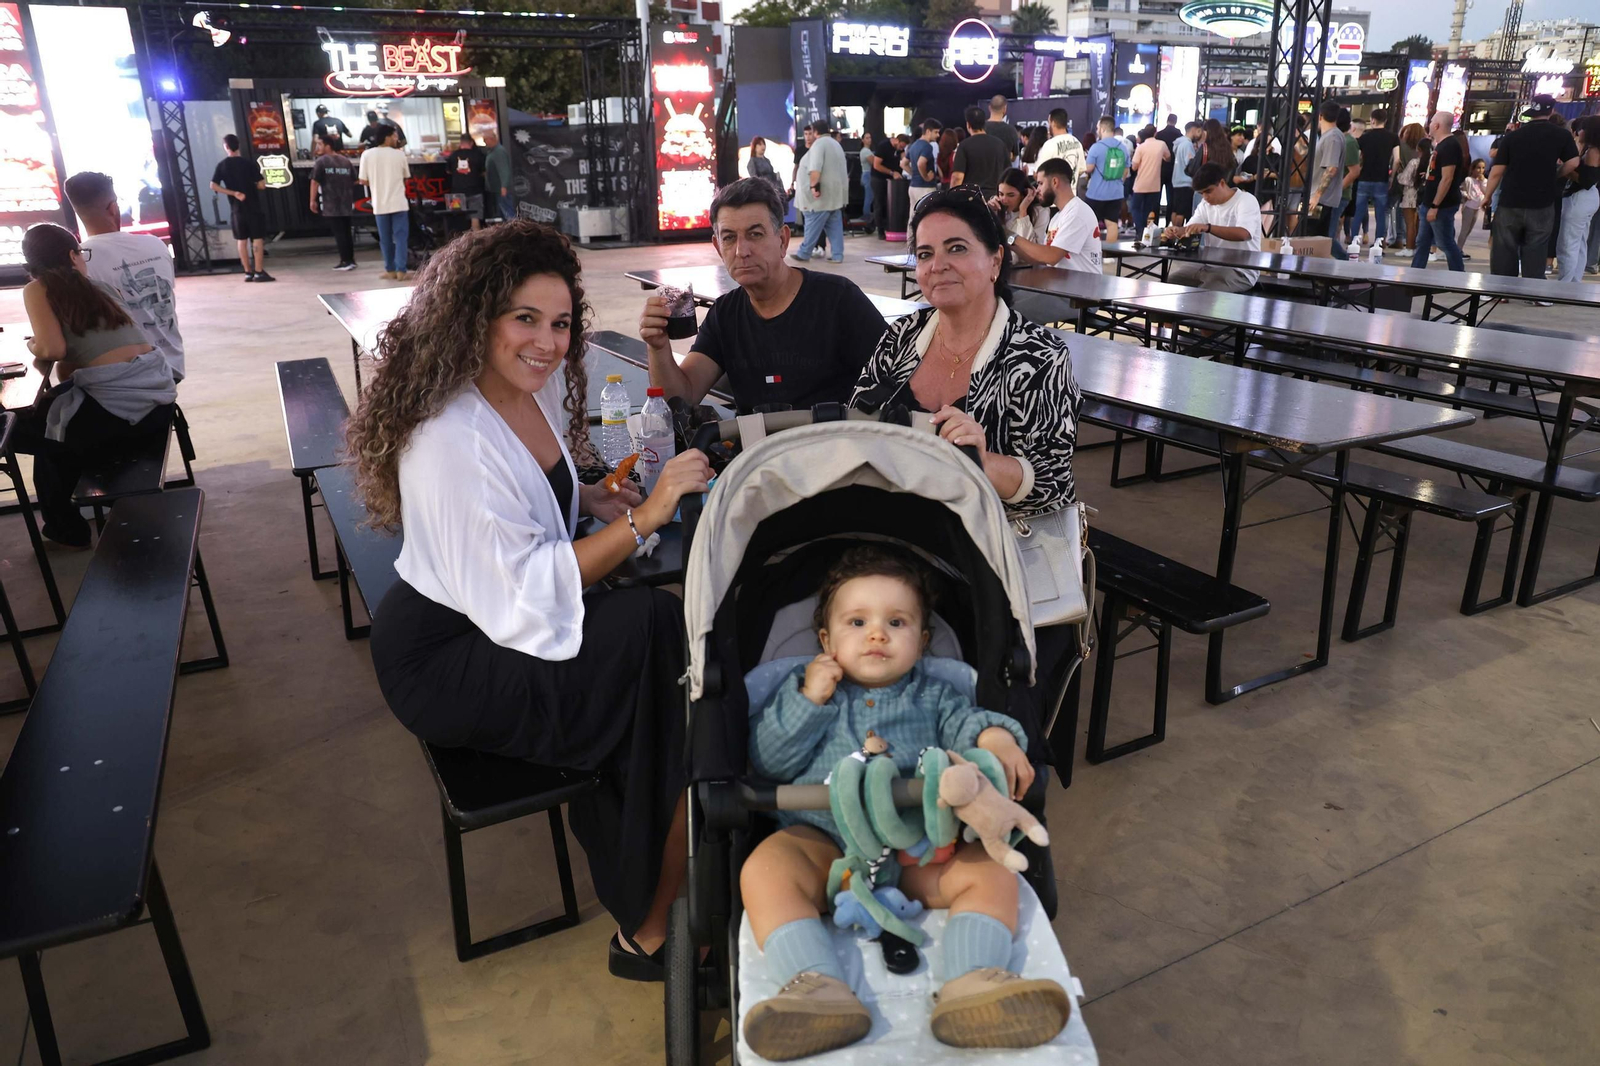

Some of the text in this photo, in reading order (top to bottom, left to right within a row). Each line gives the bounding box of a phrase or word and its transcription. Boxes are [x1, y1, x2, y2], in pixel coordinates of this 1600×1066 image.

[322, 38, 462, 73] THE BEAST
[832, 36, 908, 57] HIRO
[1032, 56, 1044, 92] HIRO
[565, 178, 587, 194] THE
